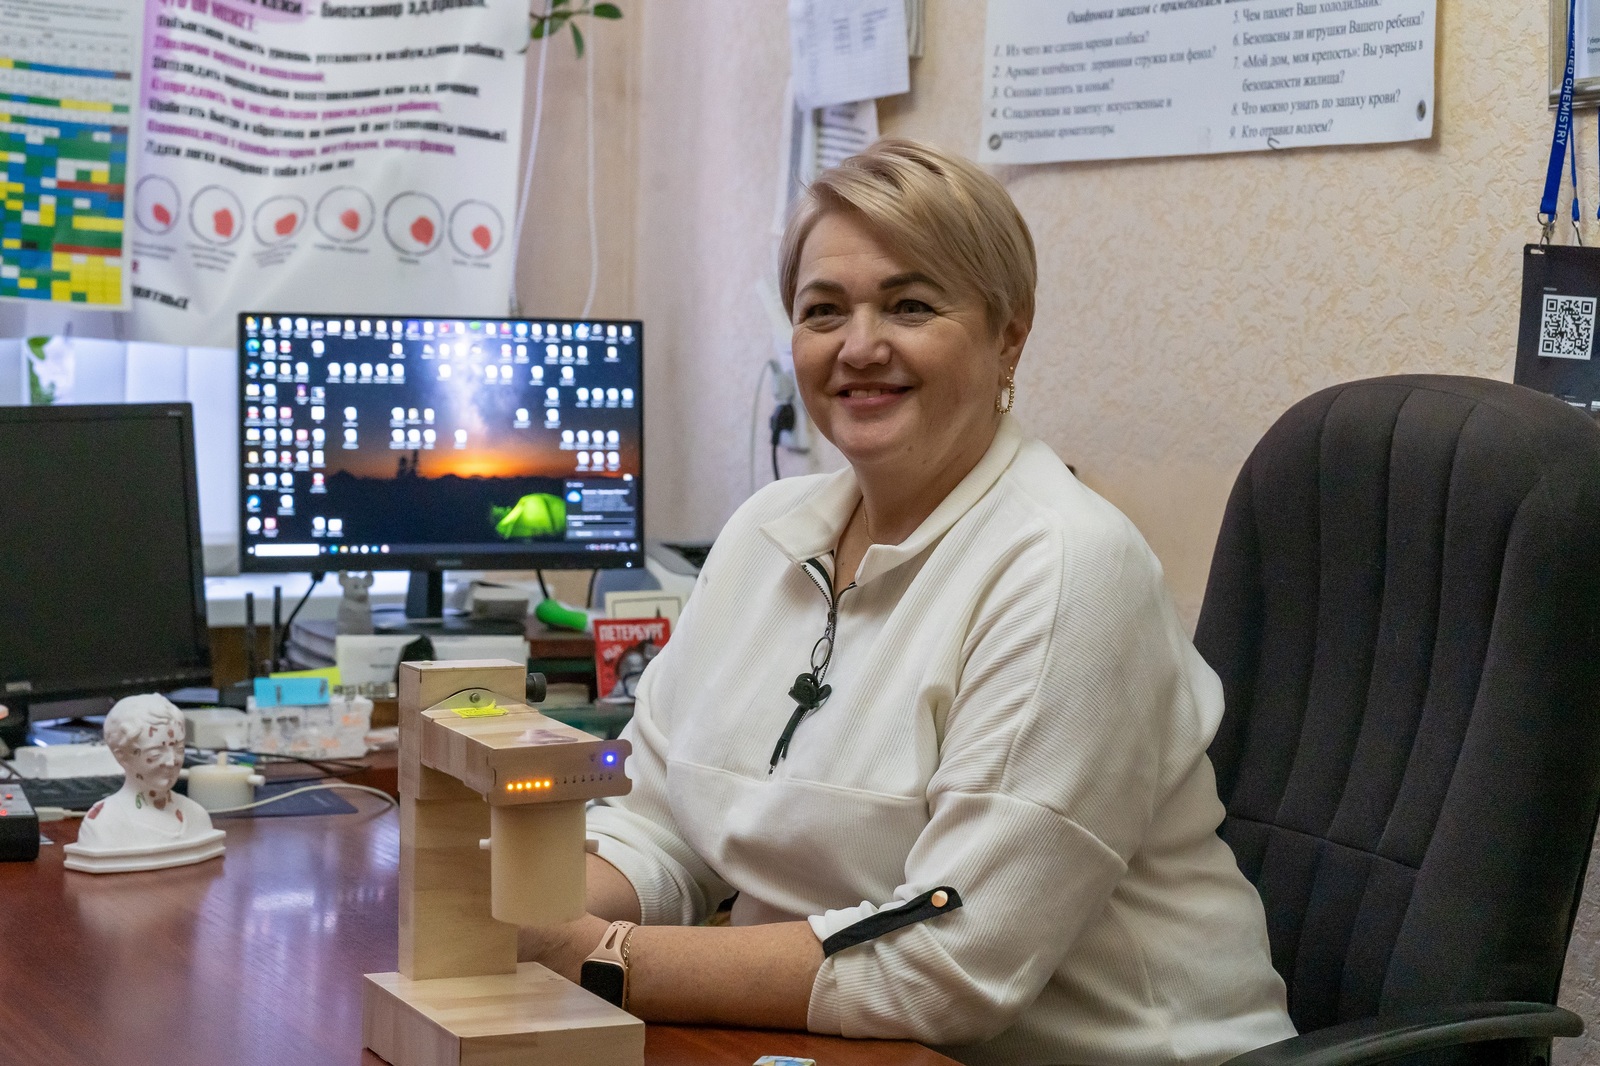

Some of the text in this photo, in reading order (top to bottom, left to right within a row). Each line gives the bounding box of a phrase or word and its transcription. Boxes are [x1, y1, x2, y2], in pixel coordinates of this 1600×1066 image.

[1243, 8, 1261, 22] Чем
[1263, 7, 1294, 20] пахнет
[1296, 2, 1317, 16] Ваш
[1243, 31, 1290, 46] Безопасны
[1292, 30, 1304, 40] ли
[1306, 25, 1347, 42] игрушки
[1349, 18, 1384, 35] Вашего
[1386, 11, 1425, 33] ребенка?
[1293, 52, 1310, 63] моя
[1363, 42, 1378, 57] Вы
[1379, 41, 1417, 59] уверены
[1418, 39, 1424, 50] в
[1242, 70, 1345, 93] безопасности жилища?
[1242, 101, 1258, 115] Что
[1259, 101, 1289, 113] можно
[1291, 99, 1320, 114] узнать
[1321, 97, 1333, 109] по
[1335, 94, 1366, 110] запаху
[1368, 88, 1401, 107] крови?
[1556, 77, 1573, 146] CHEMISTRY
[1242, 126, 1258, 138] Кто
[1295, 119, 1334, 133] водоем?
[598, 622, 665, 642] ПЕТЕРБУРГ
